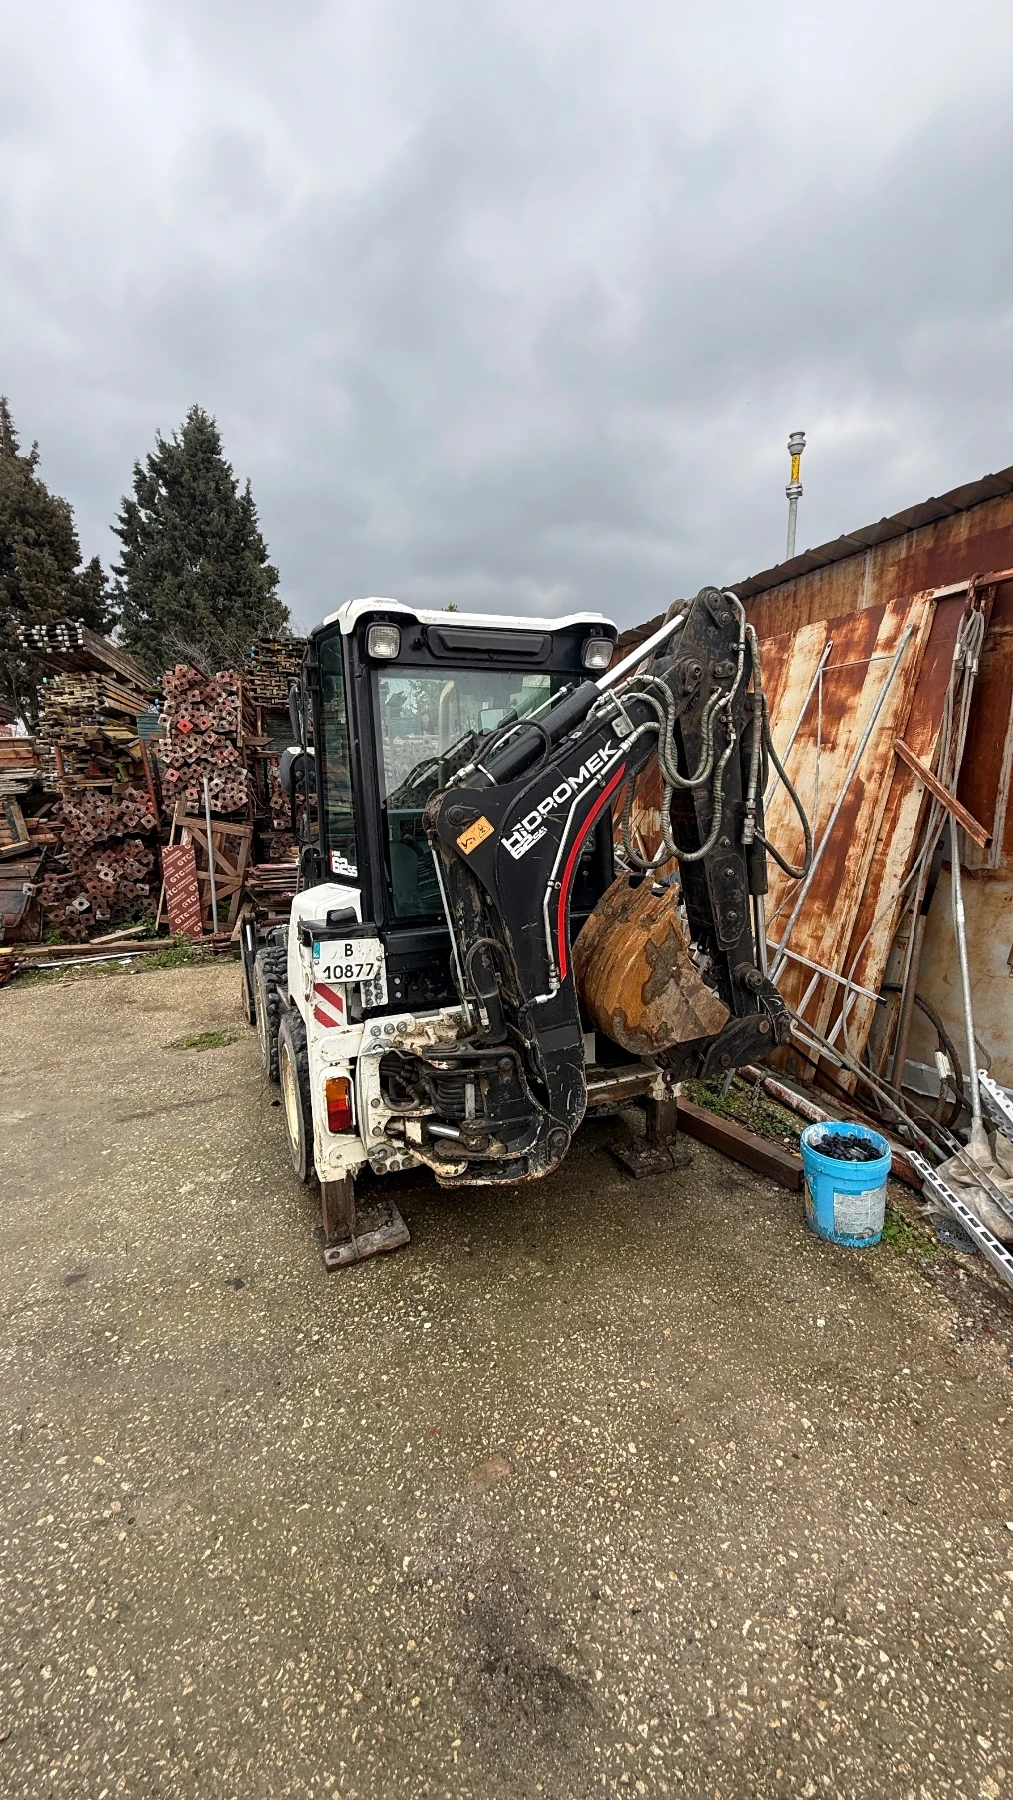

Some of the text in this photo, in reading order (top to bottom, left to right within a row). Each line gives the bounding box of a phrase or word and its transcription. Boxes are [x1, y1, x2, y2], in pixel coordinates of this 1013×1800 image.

[177, 852, 192, 866] GTC
[170, 869, 185, 883] GTC
[182, 895, 197, 908] GTC
[174, 912, 190, 924] GTC
[344, 943, 354, 957] B
[323, 963, 374, 979] 10877
